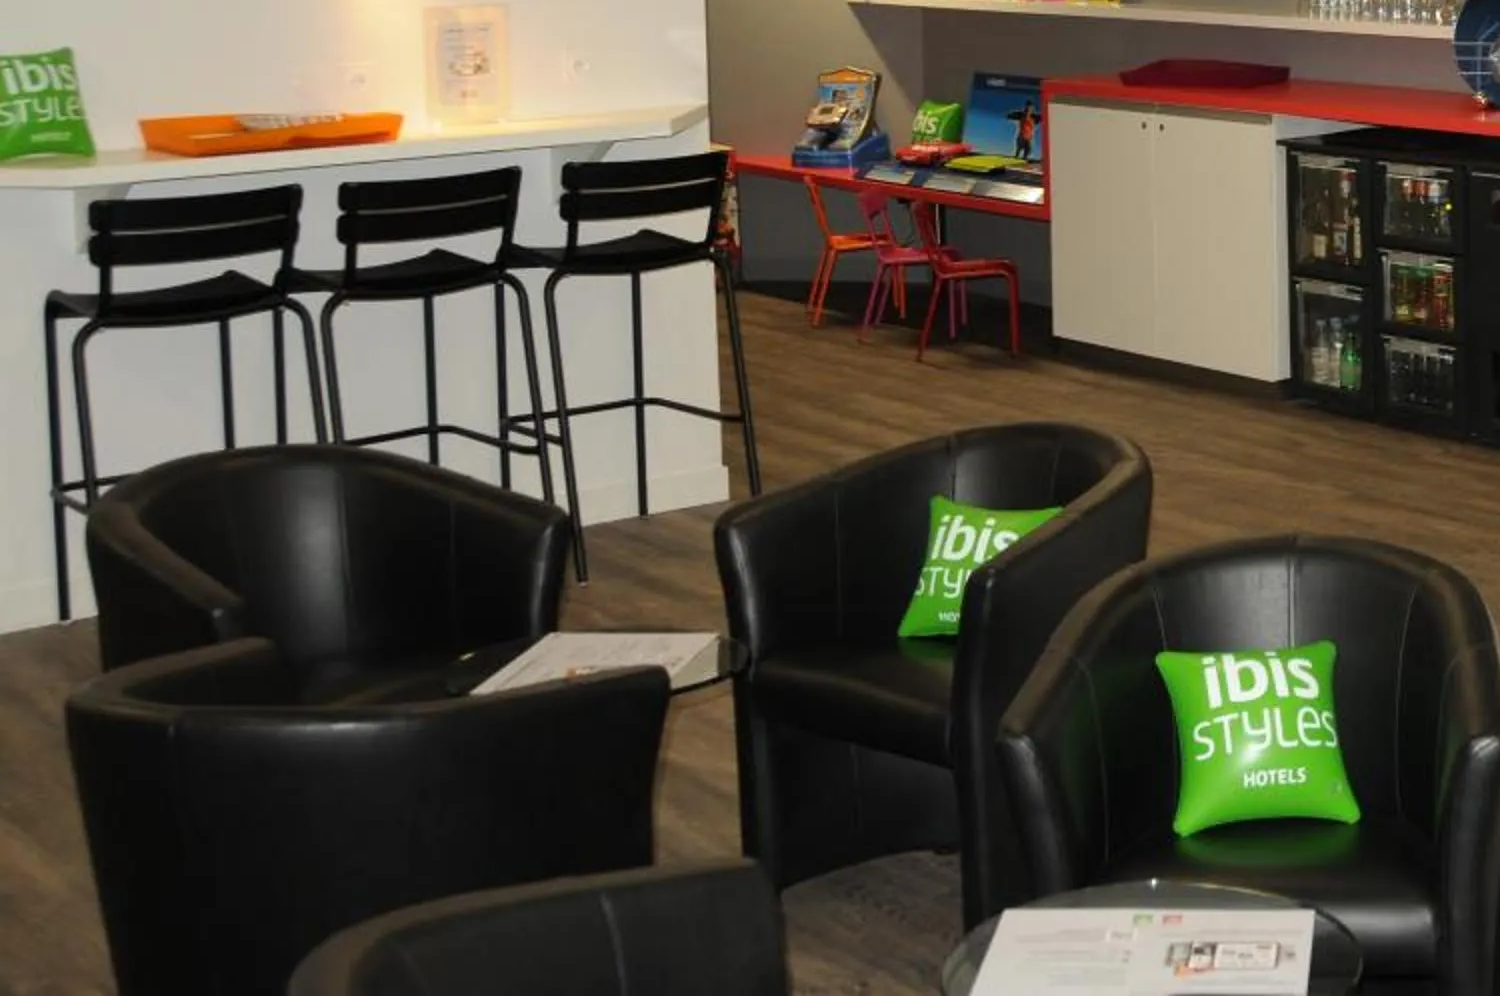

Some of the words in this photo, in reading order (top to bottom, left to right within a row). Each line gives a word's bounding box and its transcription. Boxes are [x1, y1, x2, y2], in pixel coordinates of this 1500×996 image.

[0, 57, 77, 95] ibis
[1202, 650, 1320, 709] ibis
[1242, 766, 1307, 788] HOTELS
